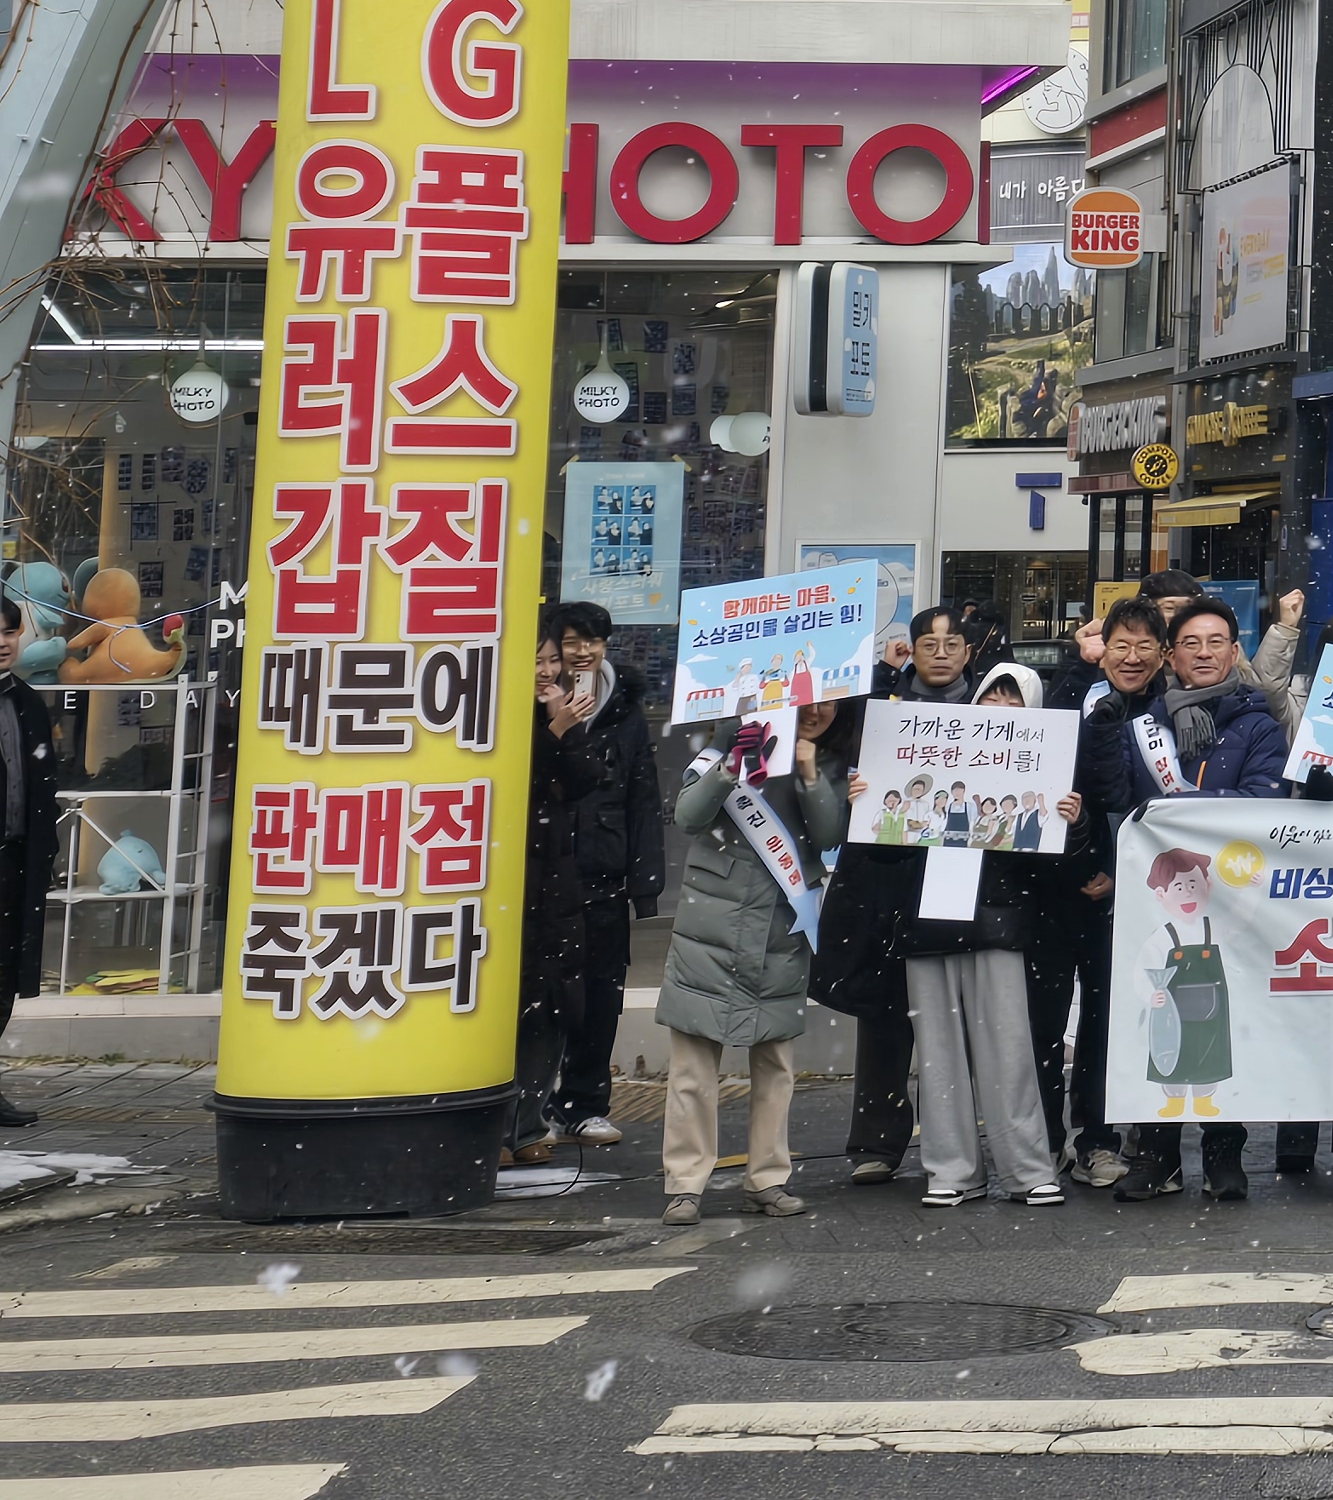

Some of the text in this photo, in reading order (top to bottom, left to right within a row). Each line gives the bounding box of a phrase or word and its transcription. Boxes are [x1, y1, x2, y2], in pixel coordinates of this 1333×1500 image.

[1000, 180, 1027, 199] 내가
[1071, 213, 1141, 230] BURGER
[1071, 229, 1141, 252] KING
[578, 397, 620, 408] PHOTO
[580, 386, 618, 396] MILKY
[172, 400, 215, 412] PHOTO
[1137, 444, 1176, 464] COMPOSE
[1139, 471, 1177, 489] COFFEE
[267, 477, 509, 642] 갑질
[723, 592, 791, 620] 함께하는
[692, 604, 862, 649] 소상공인을 살리는 힘!
[259, 639, 500, 755] 때문에
[898, 715, 1045, 743] 가까운 가게에서
[896, 743, 963, 769] 따뜻한
[249, 778, 494, 896] 판매점
[241, 899, 487, 1021] 죽겠다
